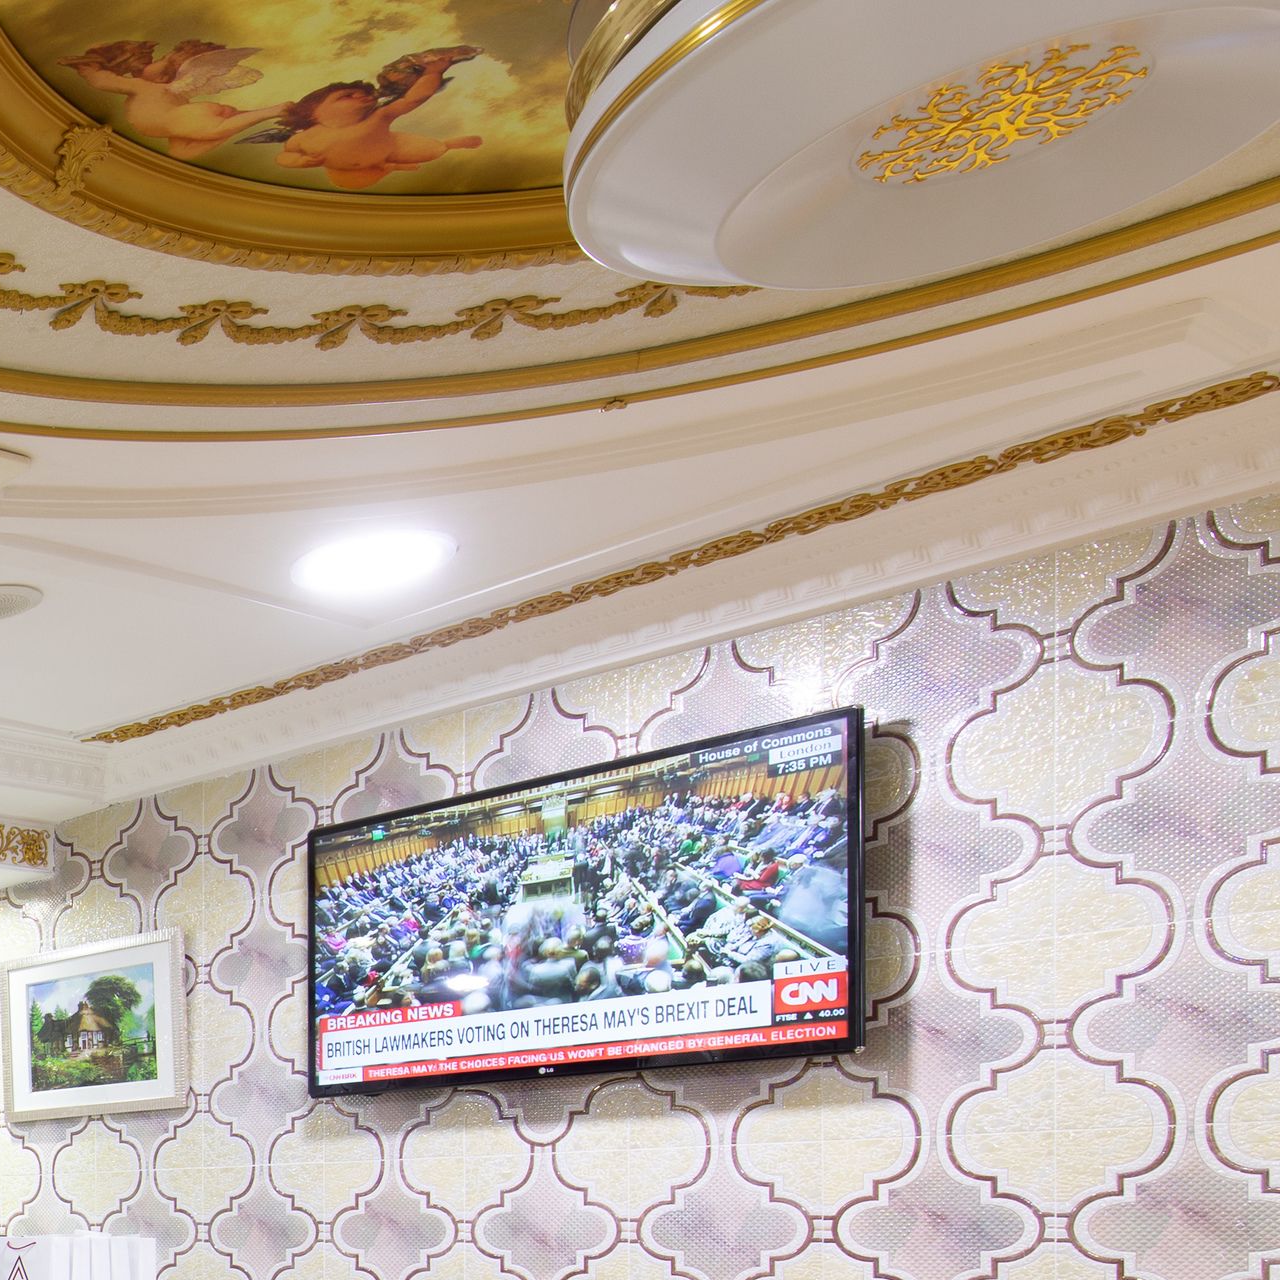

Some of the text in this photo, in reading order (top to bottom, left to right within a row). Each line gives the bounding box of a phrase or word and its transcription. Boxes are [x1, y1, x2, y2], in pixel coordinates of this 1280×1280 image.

[698, 727, 832, 764] House of Commons
[779, 740, 832, 760] London
[777, 754, 832, 774] 7:35 PM
[785, 960, 836, 975] LIVE
[780, 978, 838, 1005] CNN
[327, 1004, 454, 1030] BREAKING NEWS
[327, 1038, 370, 1058] BRITISH
[374, 1029, 452, 1053] LAWMAKERS
[458, 1024, 505, 1044] VOTING
[510, 1020, 529, 1038] ON
[534, 1013, 598, 1036] THERESA
[604, 1006, 650, 1029] MAY'S
[656, 1000, 709, 1023] BREXIT
[716, 995, 758, 1017] DEAL
[776, 1008, 844, 1022] FTSE 40.00
[368, 1067, 410, 1078] THERESA
[440, 1062, 457, 1071] THE
[460, 1057, 505, 1069] CHOICES
[508, 1053, 547, 1065] FACING
[550, 1052, 564, 1061] US
[608, 1046, 622, 1056] BE
[626, 1040, 684, 1054] CHANGED
[688, 1039, 704, 1048] BY
[708, 1032, 767, 1046] GENERAL
[771, 1026, 836, 1040] ELECTION
